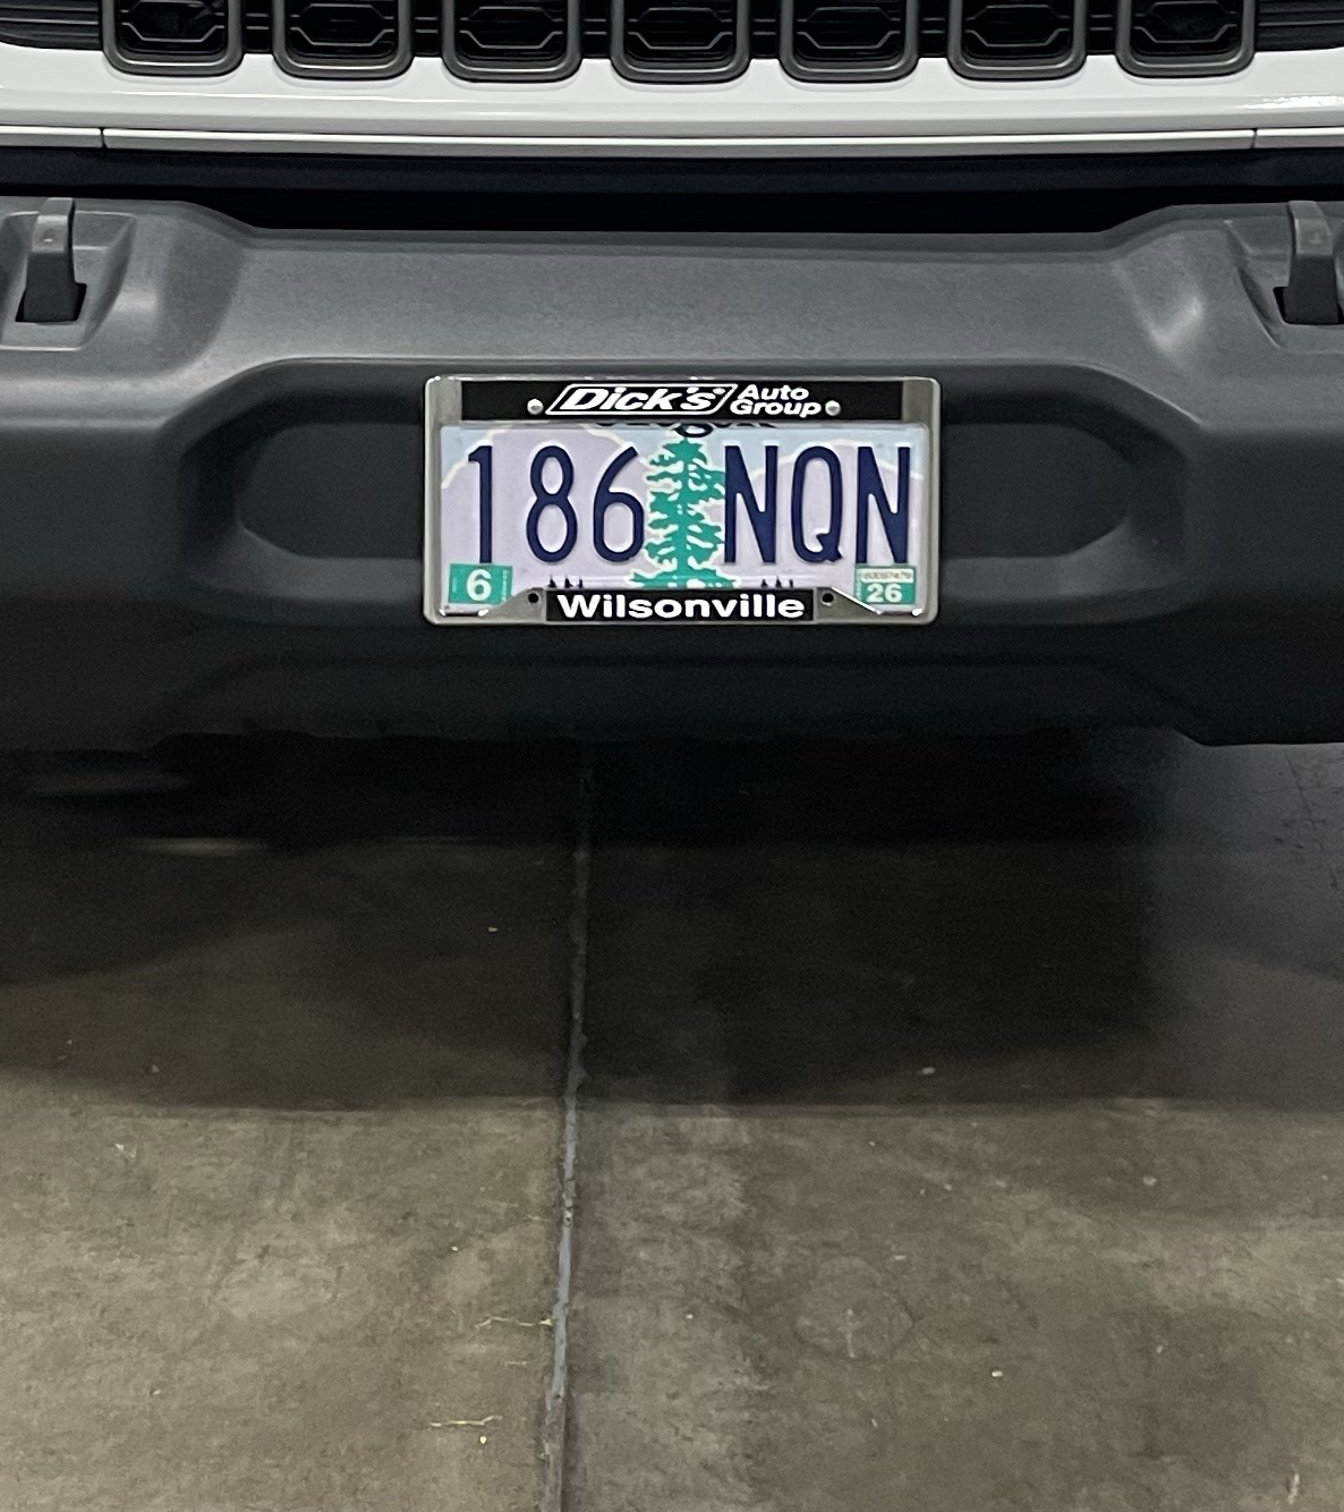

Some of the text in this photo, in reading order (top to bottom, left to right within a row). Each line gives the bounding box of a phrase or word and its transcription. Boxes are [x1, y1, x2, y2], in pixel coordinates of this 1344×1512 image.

[737, 384, 810, 400] Auto
[730, 399, 822, 418] Group
[467, 444, 911, 565] 186 NQN
[467, 568, 492, 602] 6
[866, 583, 903, 603] 26
[556, 592, 805, 620] Wilsonville
